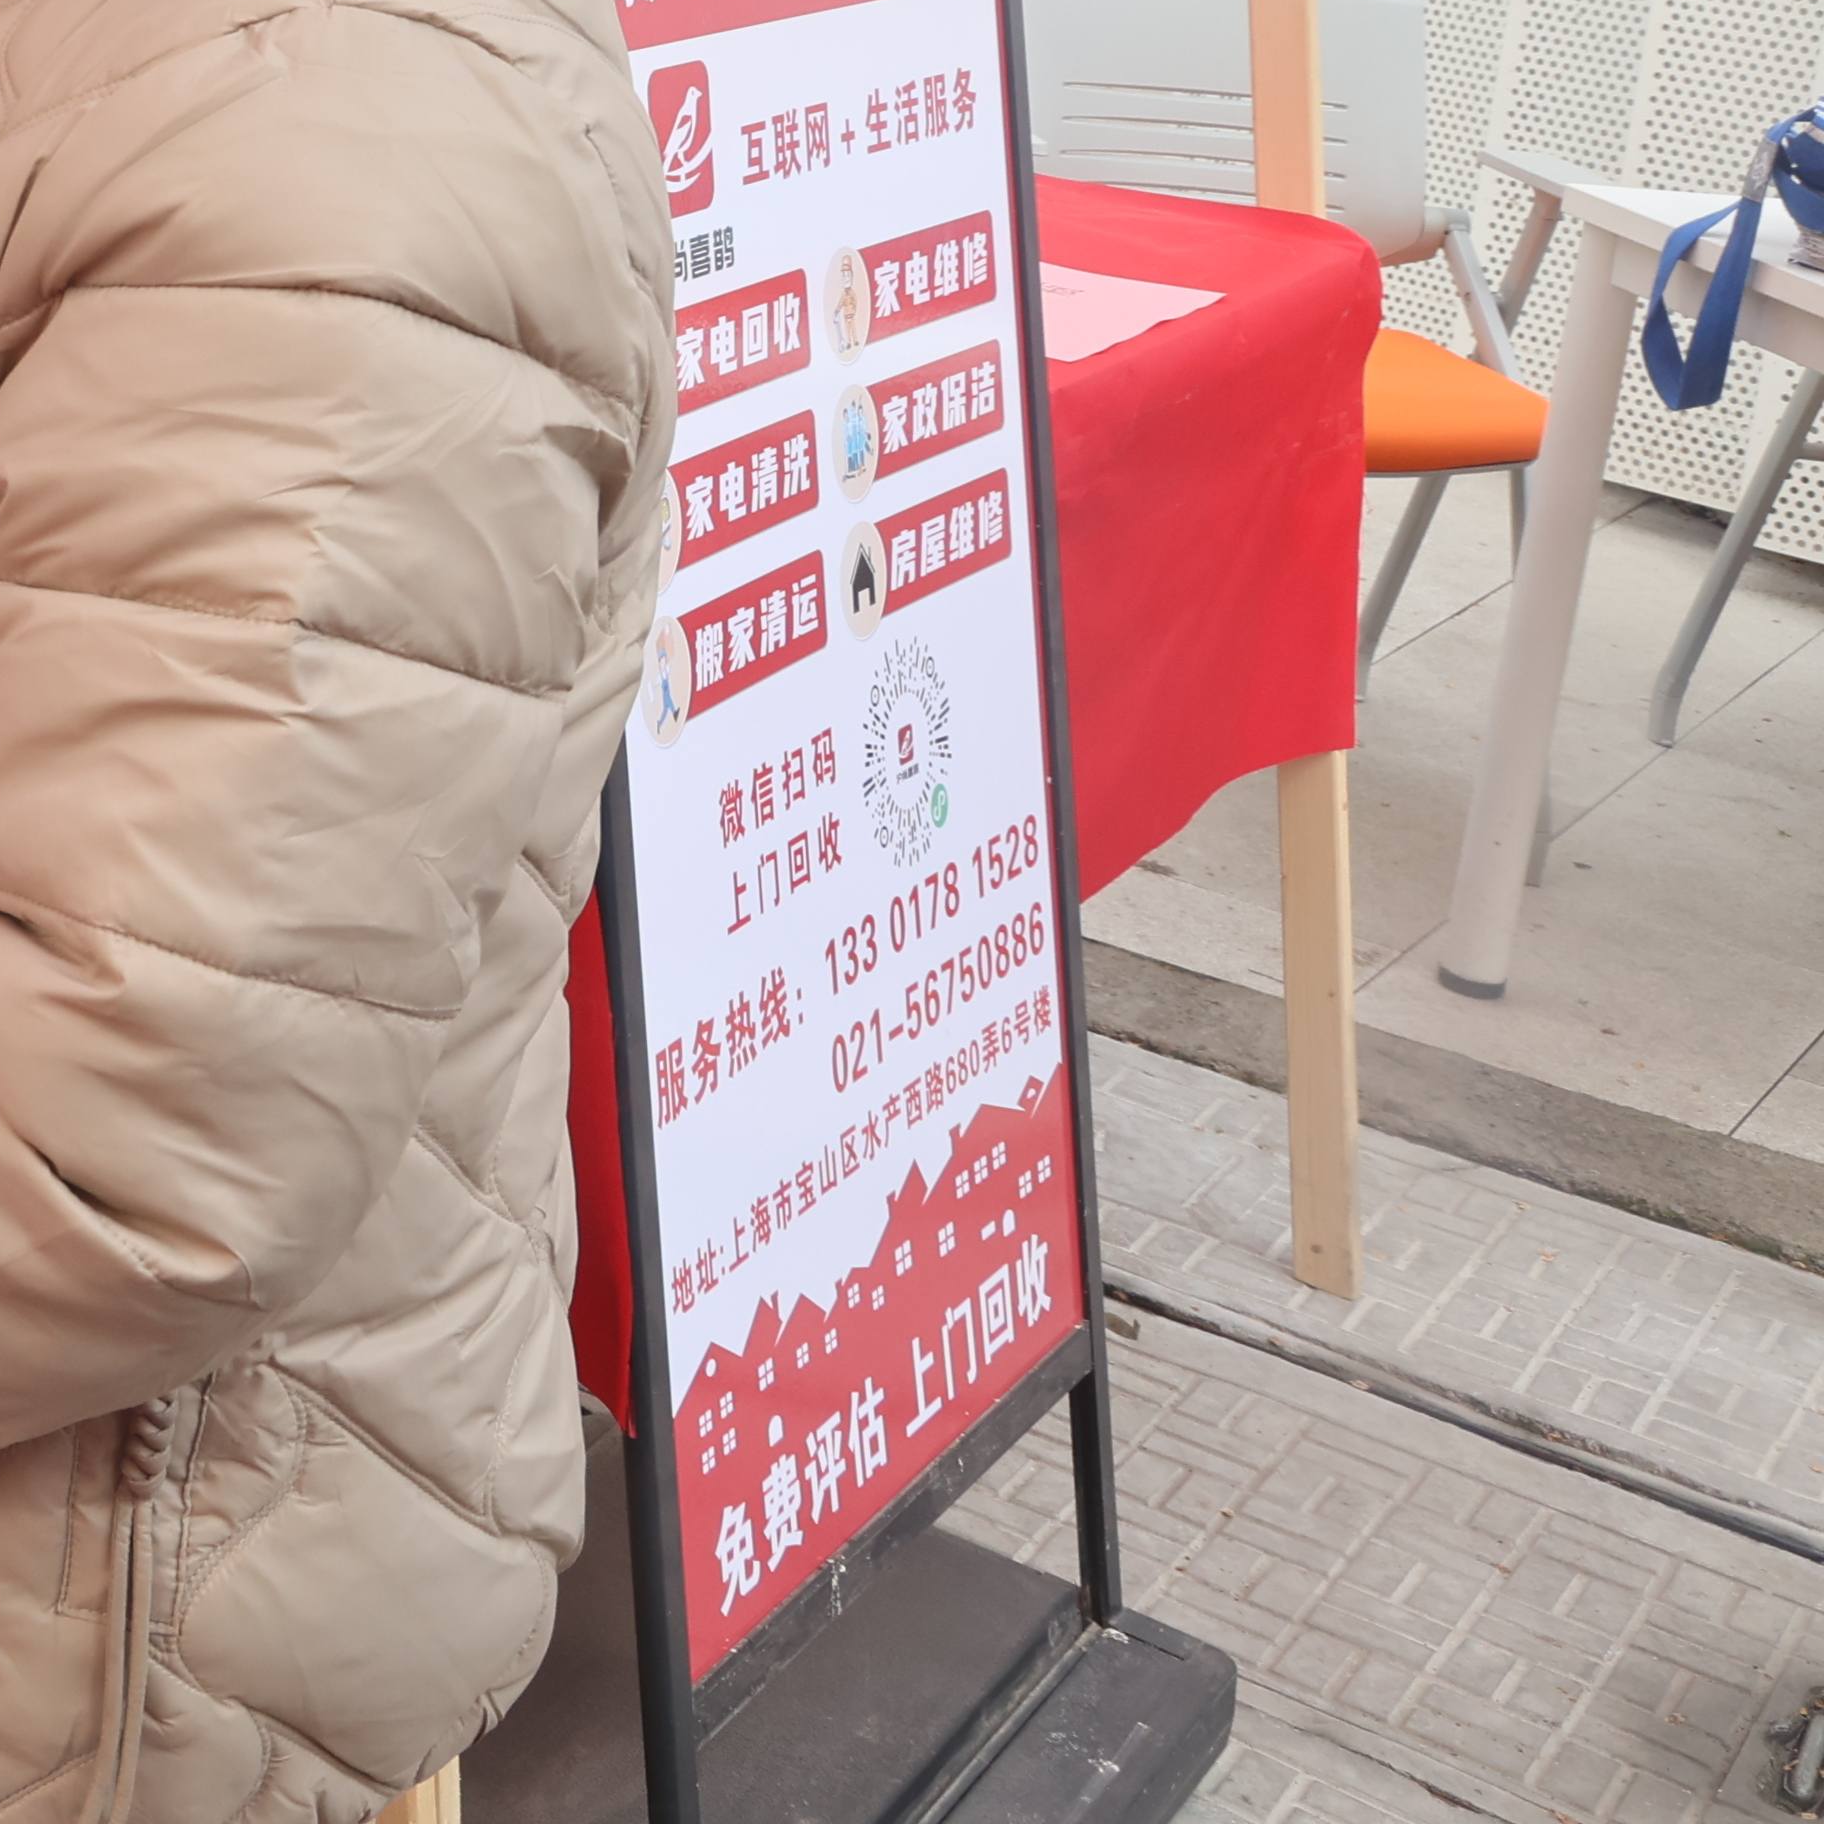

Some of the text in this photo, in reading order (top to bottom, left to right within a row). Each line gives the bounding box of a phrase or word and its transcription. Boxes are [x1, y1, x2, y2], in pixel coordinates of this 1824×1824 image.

[874, 232, 989, 318] 家电维修
[676, 292, 801, 392] 家电回收
[882, 361, 996, 454] 家政保洁
[685, 433, 811, 541] 家电清洗
[890, 490, 1004, 591] 房屋维修
[695, 574, 820, 692] 搬家清运
[719, 727, 837, 849] 微信扫码
[727, 812, 843, 935] 上门回收
[824, 914, 878, 995] 133
[889, 862, 960, 954] 0178
[971, 814, 1039, 899] 1528
[832, 902, 1045, 1093] 021-56750886
[715, 1234, 1052, 1617] 免费评估 上门回收
